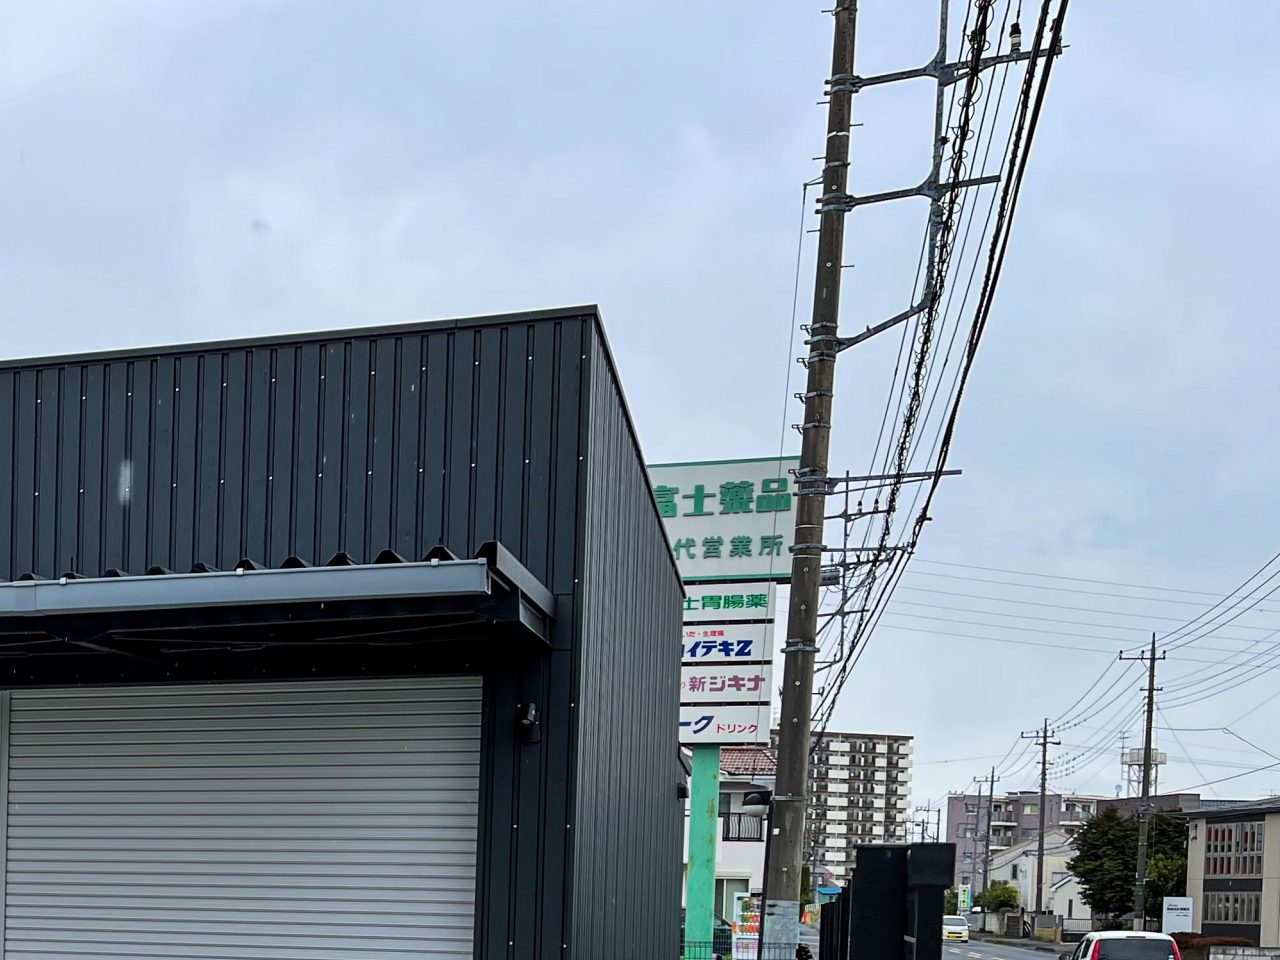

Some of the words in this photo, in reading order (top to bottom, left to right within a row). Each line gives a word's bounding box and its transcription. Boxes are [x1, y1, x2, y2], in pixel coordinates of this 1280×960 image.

[654, 478, 791, 518] 富士薬品
[673, 535, 784, 560] 代営業所
[681, 640, 754, 657] イテキZ
[716, 724, 758, 734] ドリンク
